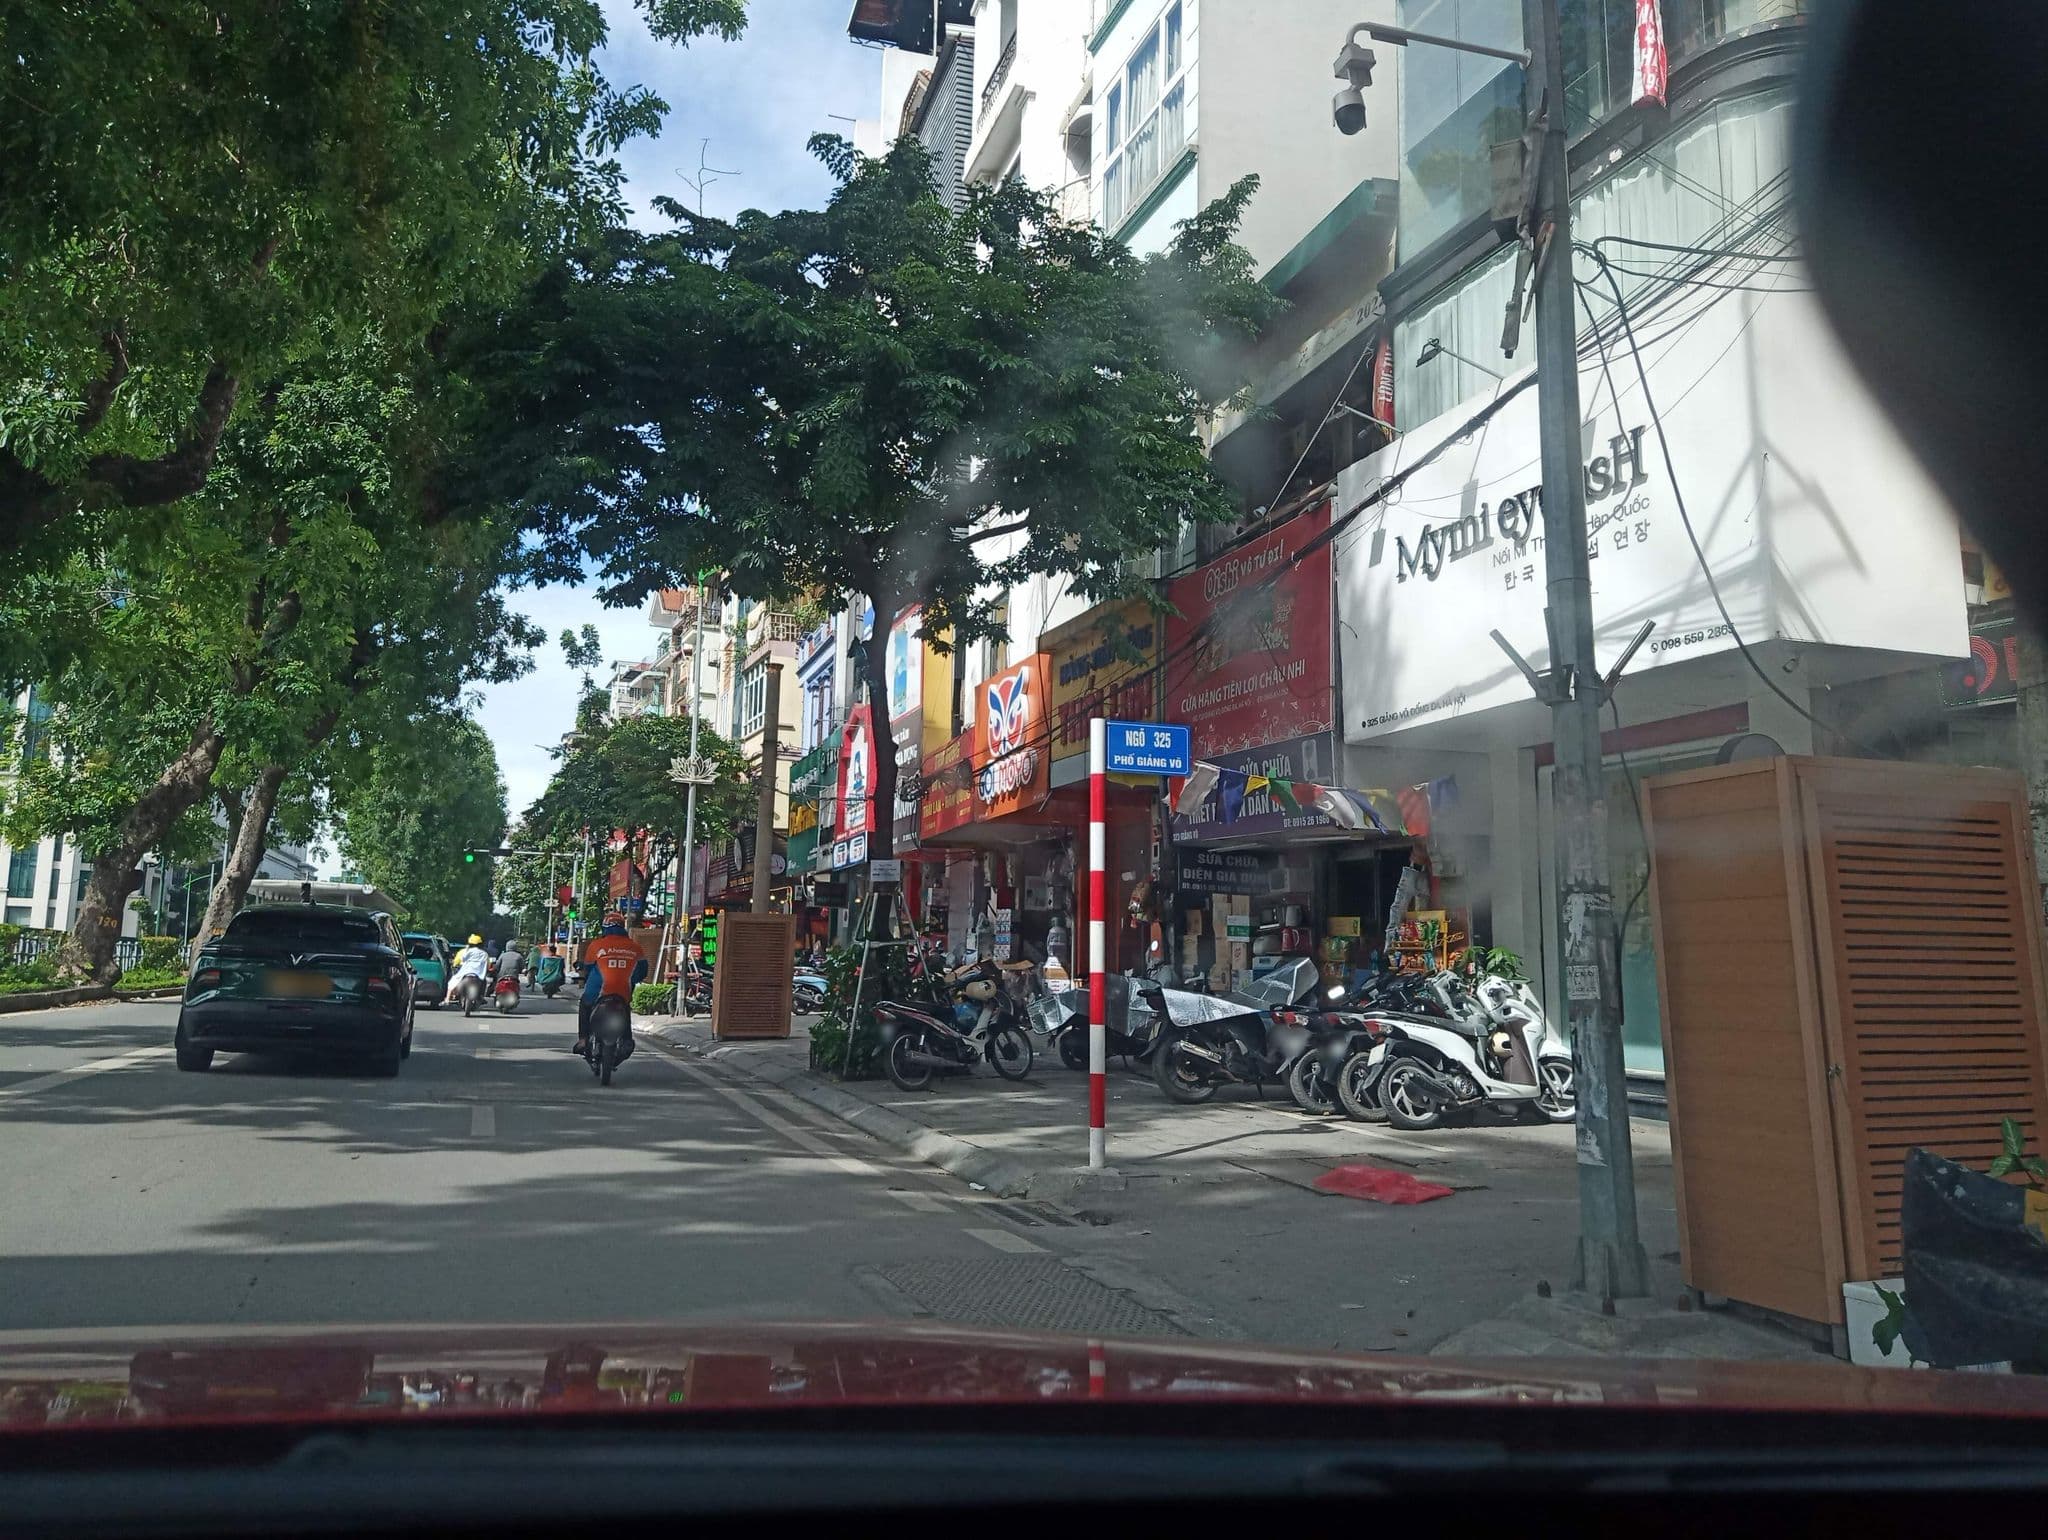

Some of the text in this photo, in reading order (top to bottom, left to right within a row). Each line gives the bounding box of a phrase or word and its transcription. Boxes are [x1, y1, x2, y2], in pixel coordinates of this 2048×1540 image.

[1493, 546, 1511, 568] Nối
[1514, 540, 1527, 560] Mi
[1613, 493, 1650, 522] Quốc
[1395, 502, 1495, 584] Mymi
[1660, 637, 1682, 651] 098
[1684, 631, 1704, 645] 559
[1181, 693, 1197, 713] CỬA
[1198, 687, 1222, 708] HÀNG
[1223, 680, 1242, 702] TIỆN
[1243, 674, 1258, 696] LỢI
[1260, 665, 1286, 689] CHÂU
[1287, 658, 1305, 680] NHI
[1367, 718, 1378, 728] 325
[1125, 727, 1171, 749] NGÕ 325
[1114, 752, 1182, 769] PHỐ GIẢNG VÕ
[1262, 753, 1292, 778] CHỮA
[1183, 866, 1213, 882] ĐIỆN
[1216, 869, 1237, 882] GIA
